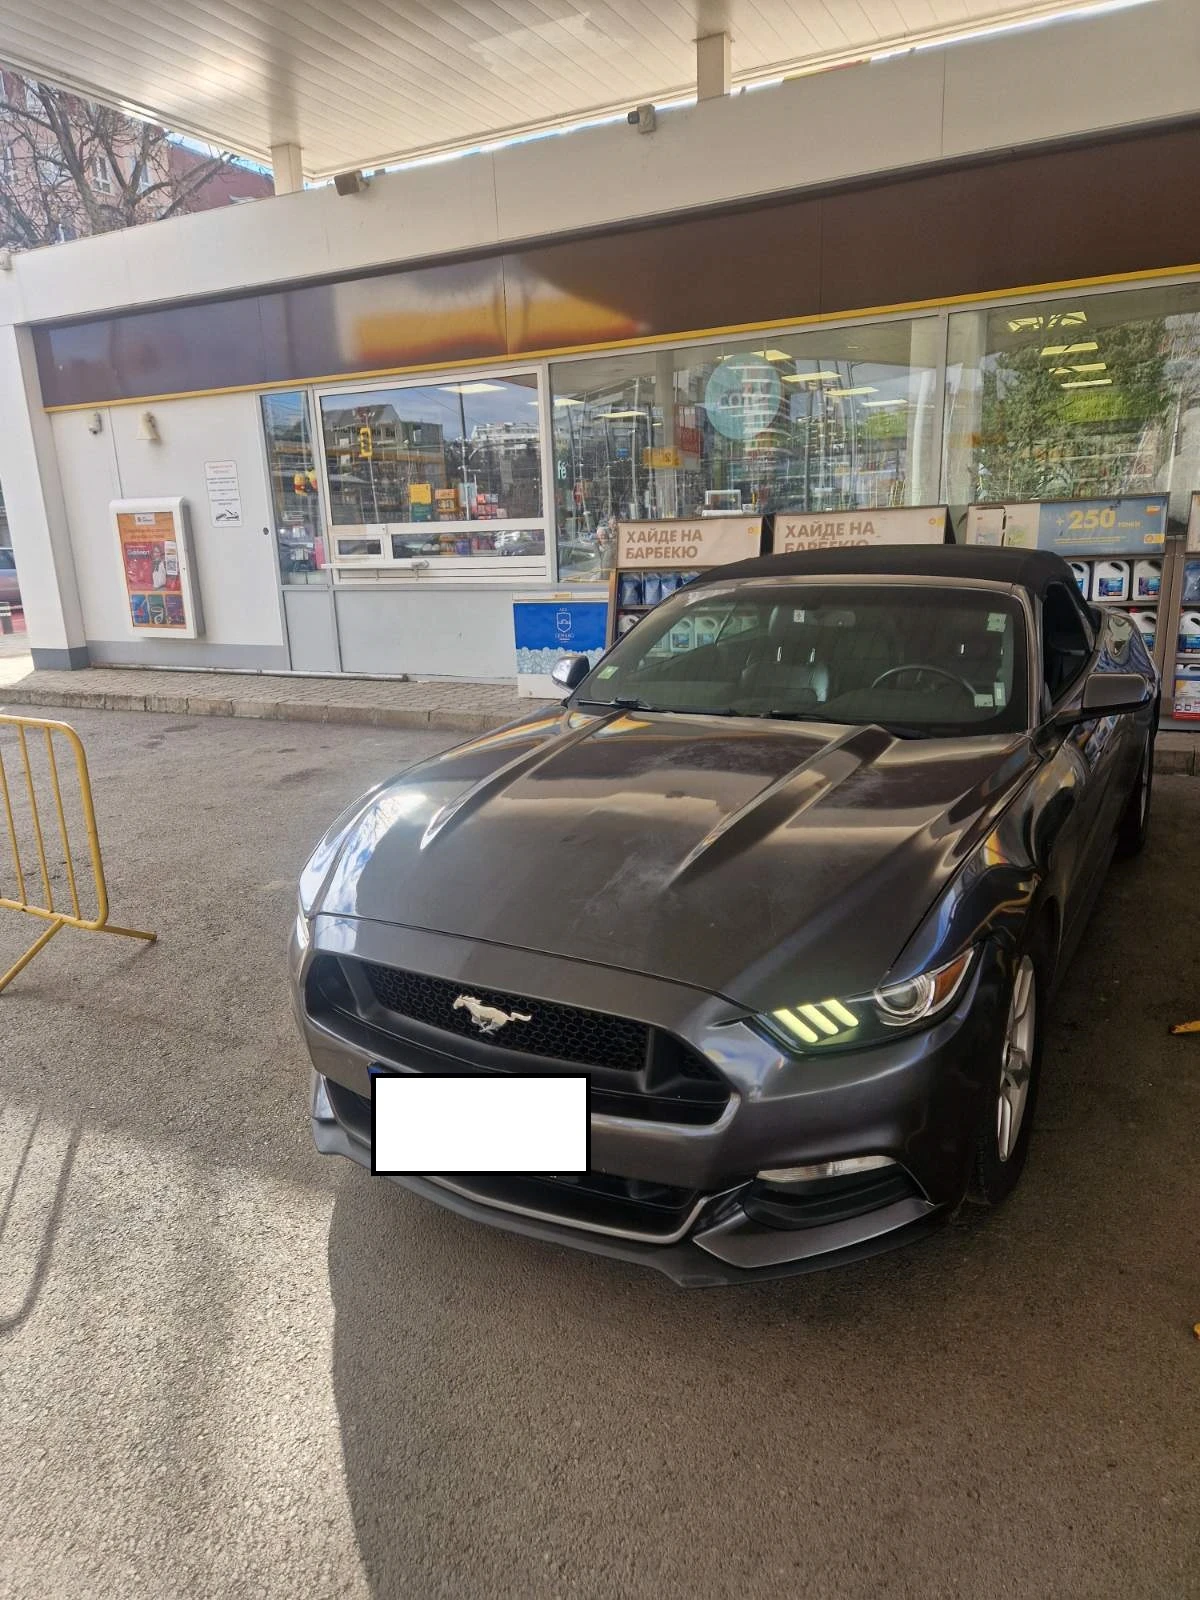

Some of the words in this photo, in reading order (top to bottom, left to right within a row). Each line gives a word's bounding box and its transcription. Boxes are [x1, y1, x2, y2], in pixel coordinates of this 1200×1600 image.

[1068, 509, 1116, 529] 250
[626, 528, 677, 545] ХАЙДЕ
[681, 528, 703, 543] НА
[785, 520, 846, 540] ХАЙДЕ
[849, 521, 875, 537] НА
[626, 546, 698, 560] БАРБЕКЮ
